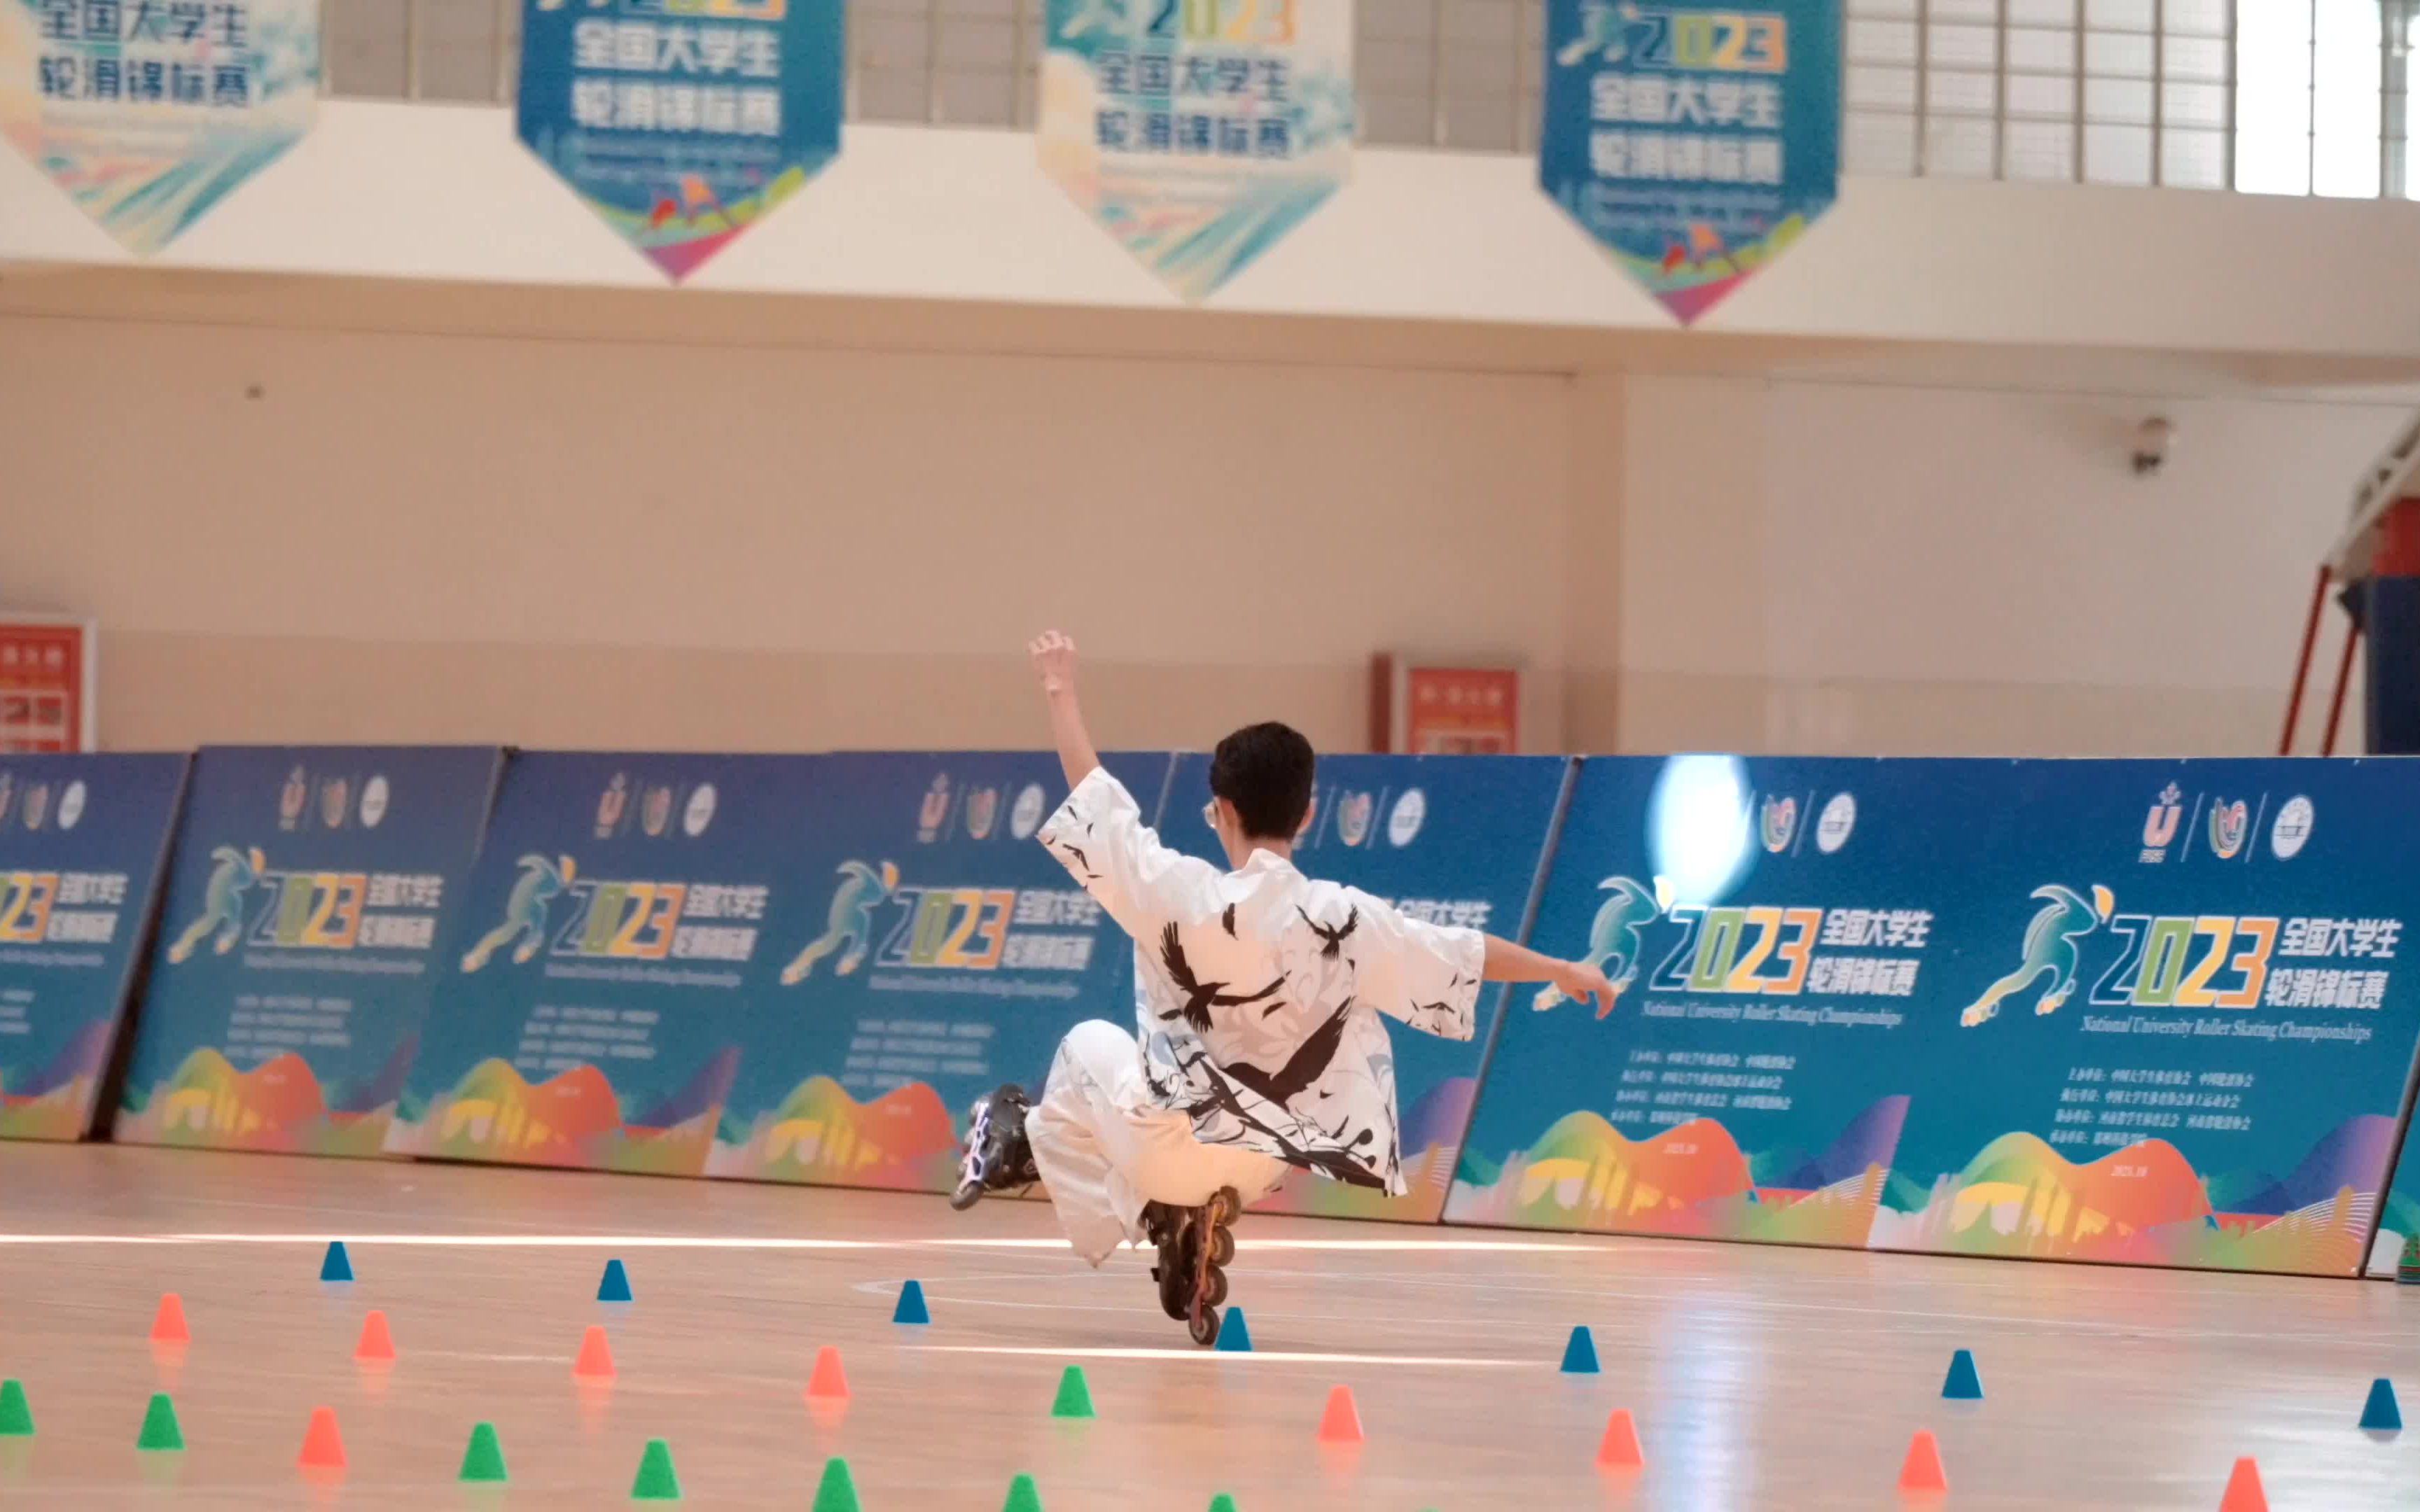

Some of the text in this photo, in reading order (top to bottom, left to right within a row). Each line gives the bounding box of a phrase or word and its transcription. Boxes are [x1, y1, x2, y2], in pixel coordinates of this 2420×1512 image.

[40, 0, 248, 47] 全国大学生
[572, 18, 780, 76] 全国大学生
[1632, 10, 1787, 74] 2023
[39, 56, 250, 108] 轮滑锦标赛
[1097, 50, 1290, 102] 全国大学生
[1590, 71, 1783, 128] 全国大学生
[571, 77, 781, 136] 轮滑锦标赛
[1096, 109, 1292, 160] 轮滑锦标赛
[247, 872, 368, 948] 2023
[550, 879, 687, 960] 2023
[875, 886, 1017, 969] 2023
[1821, 909, 1933, 948] 全国大学生
[2278, 918, 2403, 958] 全国大学生
[1649, 905, 1823, 995] 2023
[2089, 915, 2280, 1009] 2023
[2265, 968, 2390, 1009] 轮滑锦标赛
[2080, 1016, 2372, 1044] National University Roller Skating Championships
